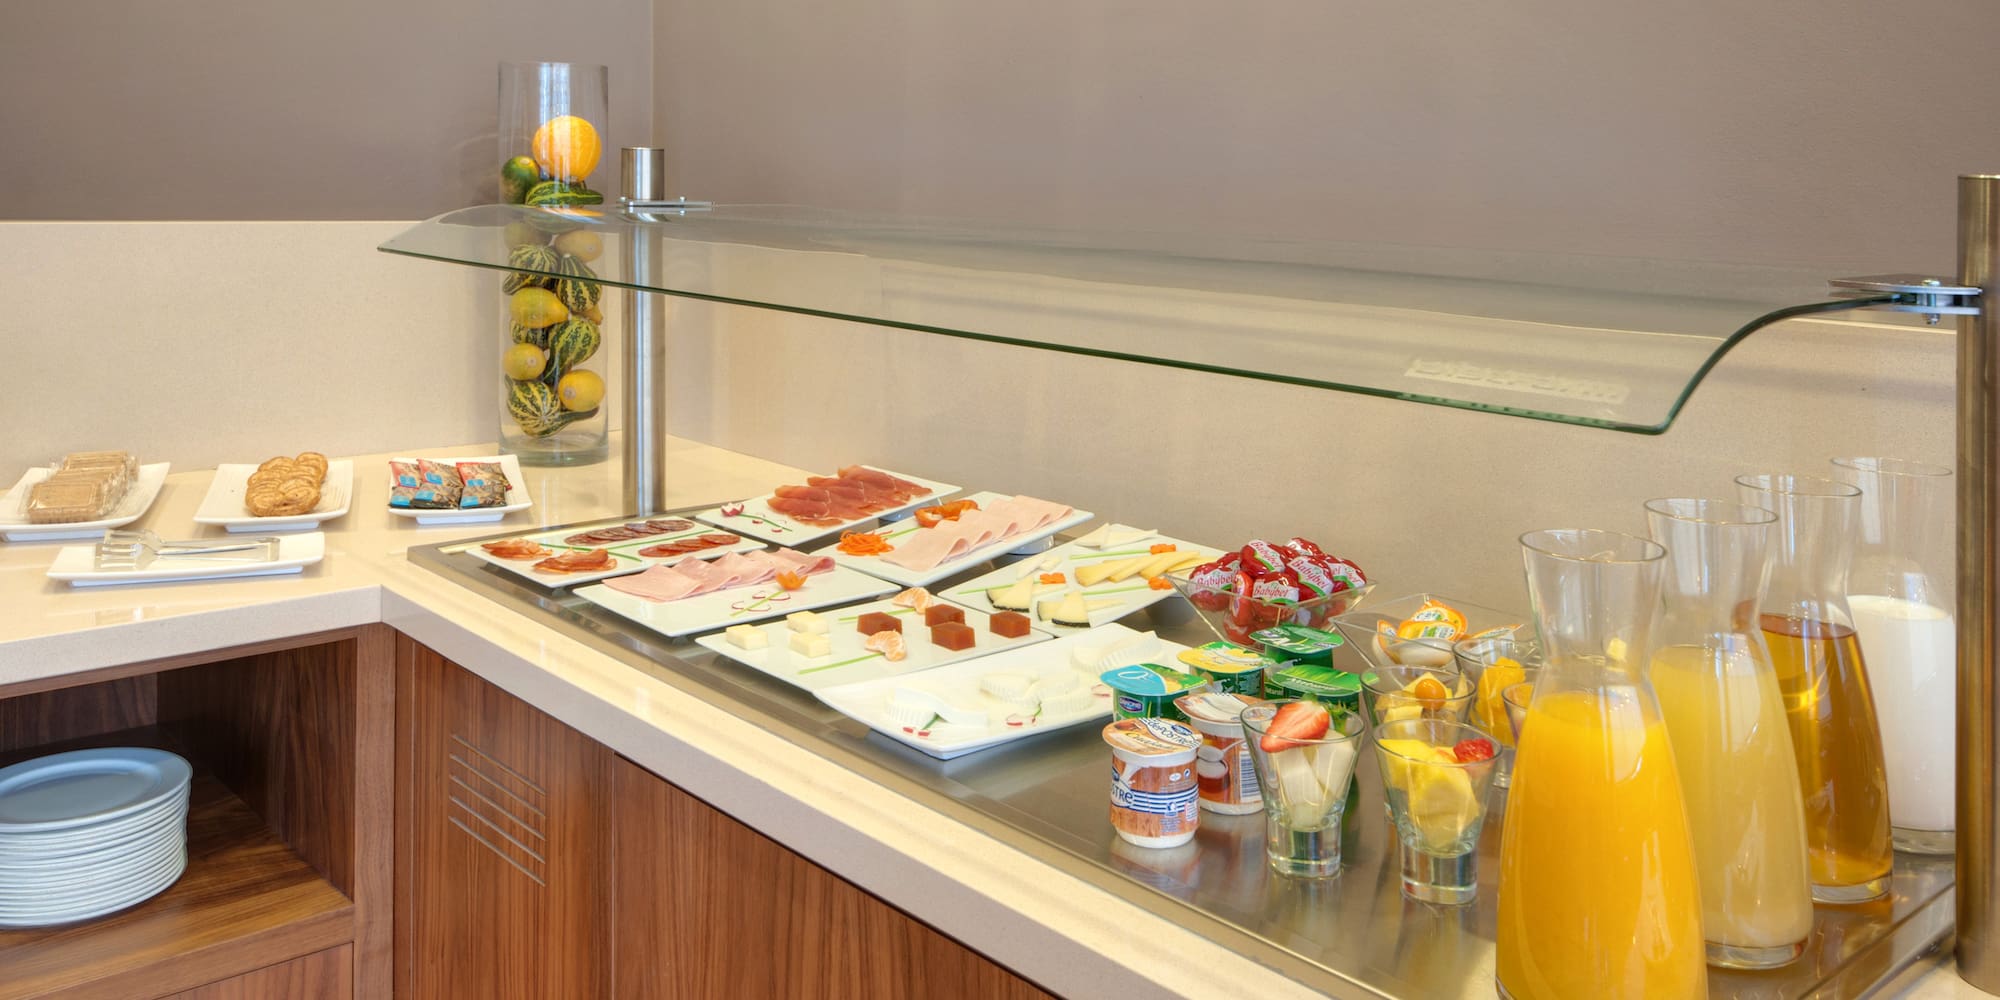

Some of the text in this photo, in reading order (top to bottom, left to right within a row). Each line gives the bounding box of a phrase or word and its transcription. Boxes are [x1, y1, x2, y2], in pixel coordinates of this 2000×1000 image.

[1250, 541, 1283, 569] Babybel
[1291, 558, 1329, 589] Babybel
[1254, 585, 1289, 598] Babybel
